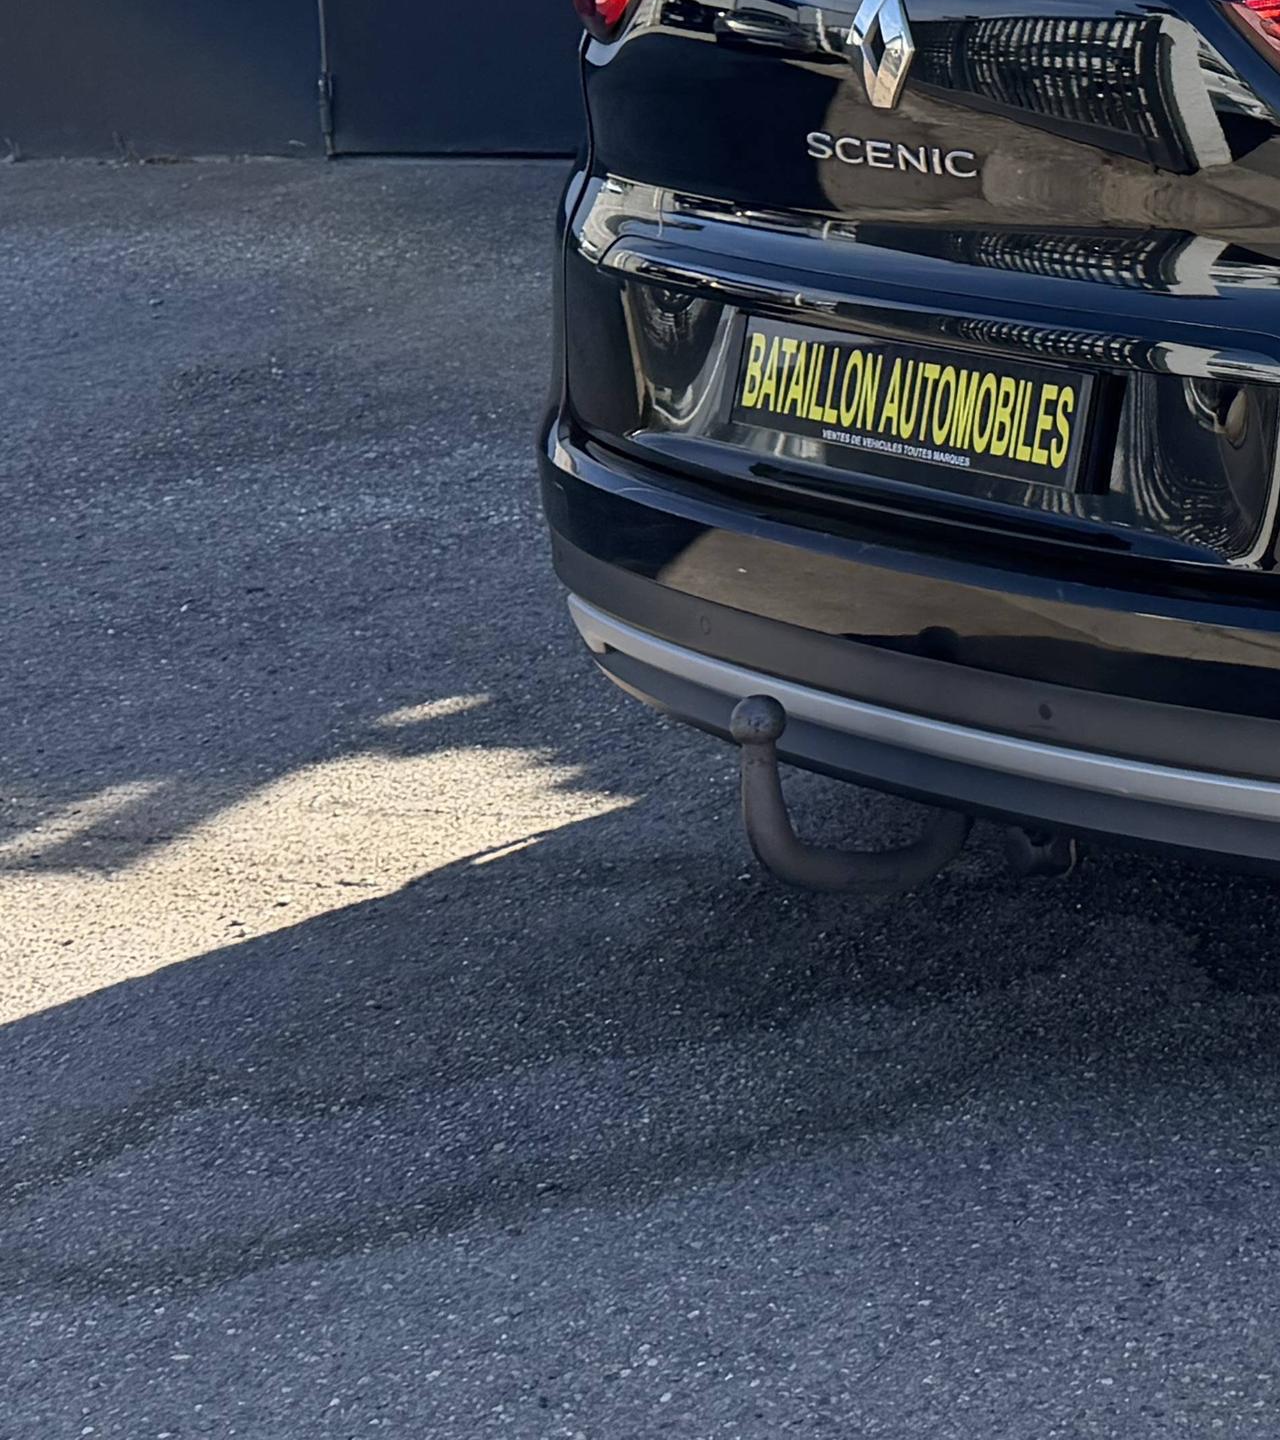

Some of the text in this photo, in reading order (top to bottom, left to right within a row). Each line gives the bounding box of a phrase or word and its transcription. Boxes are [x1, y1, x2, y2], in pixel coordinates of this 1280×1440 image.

[806, 131, 977, 178] SCENIC
[741, 332, 1075, 469] BATAILLON AUTOMOBILES
[822, 429, 971, 467] VENTES DE VEHICULES TOUTES MARQUES
